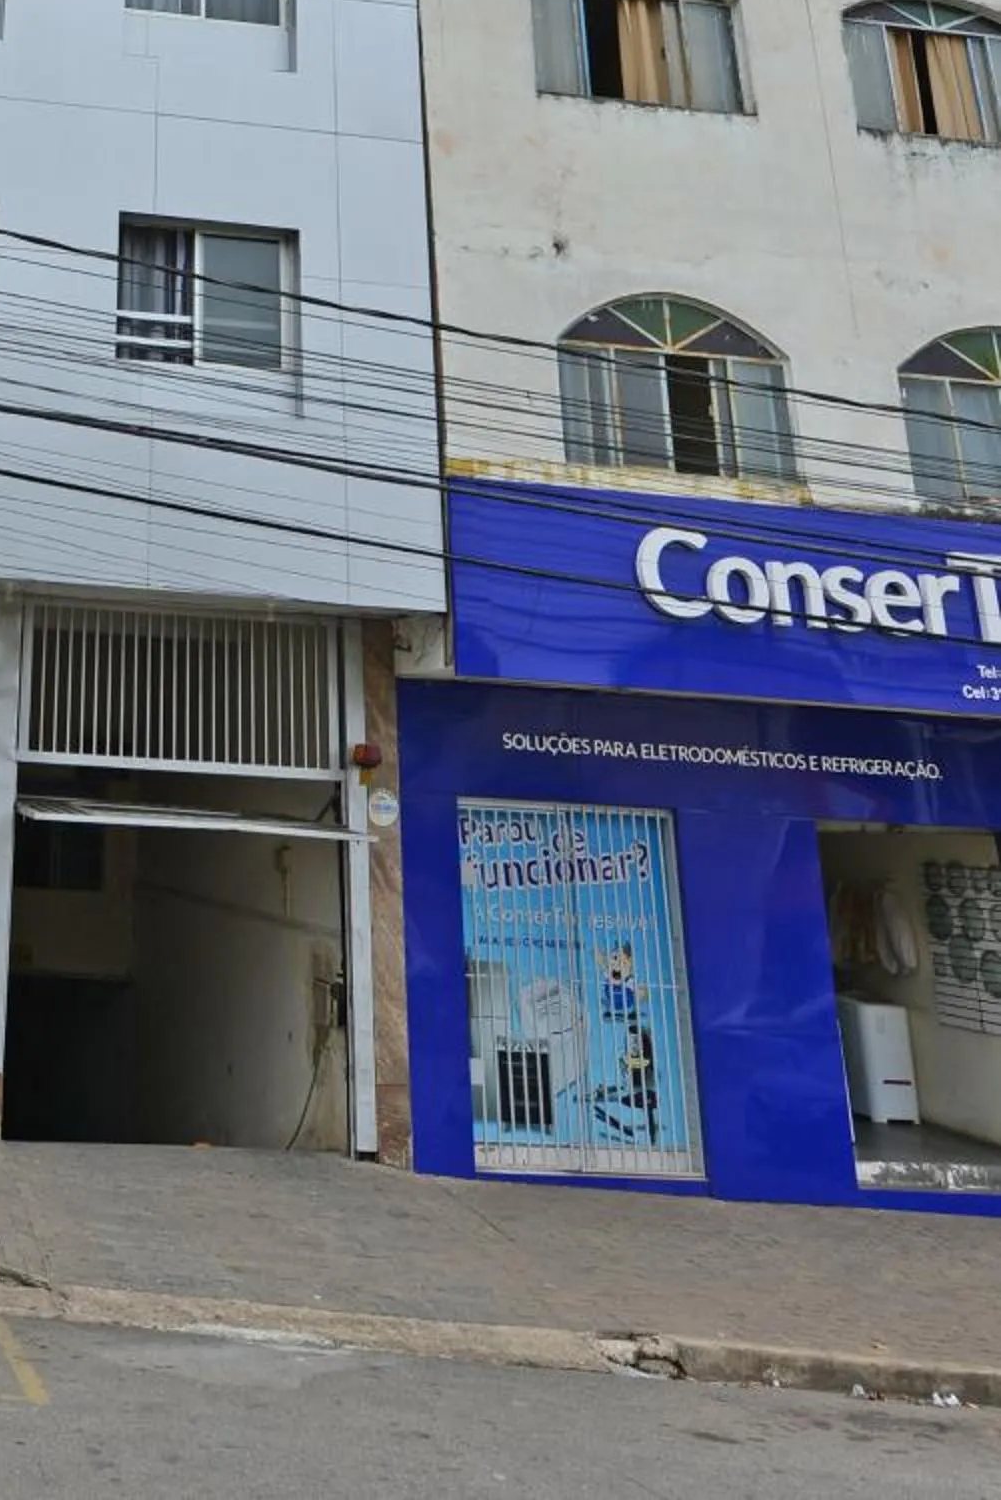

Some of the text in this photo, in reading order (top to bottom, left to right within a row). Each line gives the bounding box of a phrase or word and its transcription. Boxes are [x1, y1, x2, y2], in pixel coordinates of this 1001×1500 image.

[502, 732, 944, 781] SOLUÇÕES PARA ELETRODOMÉSTICOS E REFRIGERAÇÃO.
